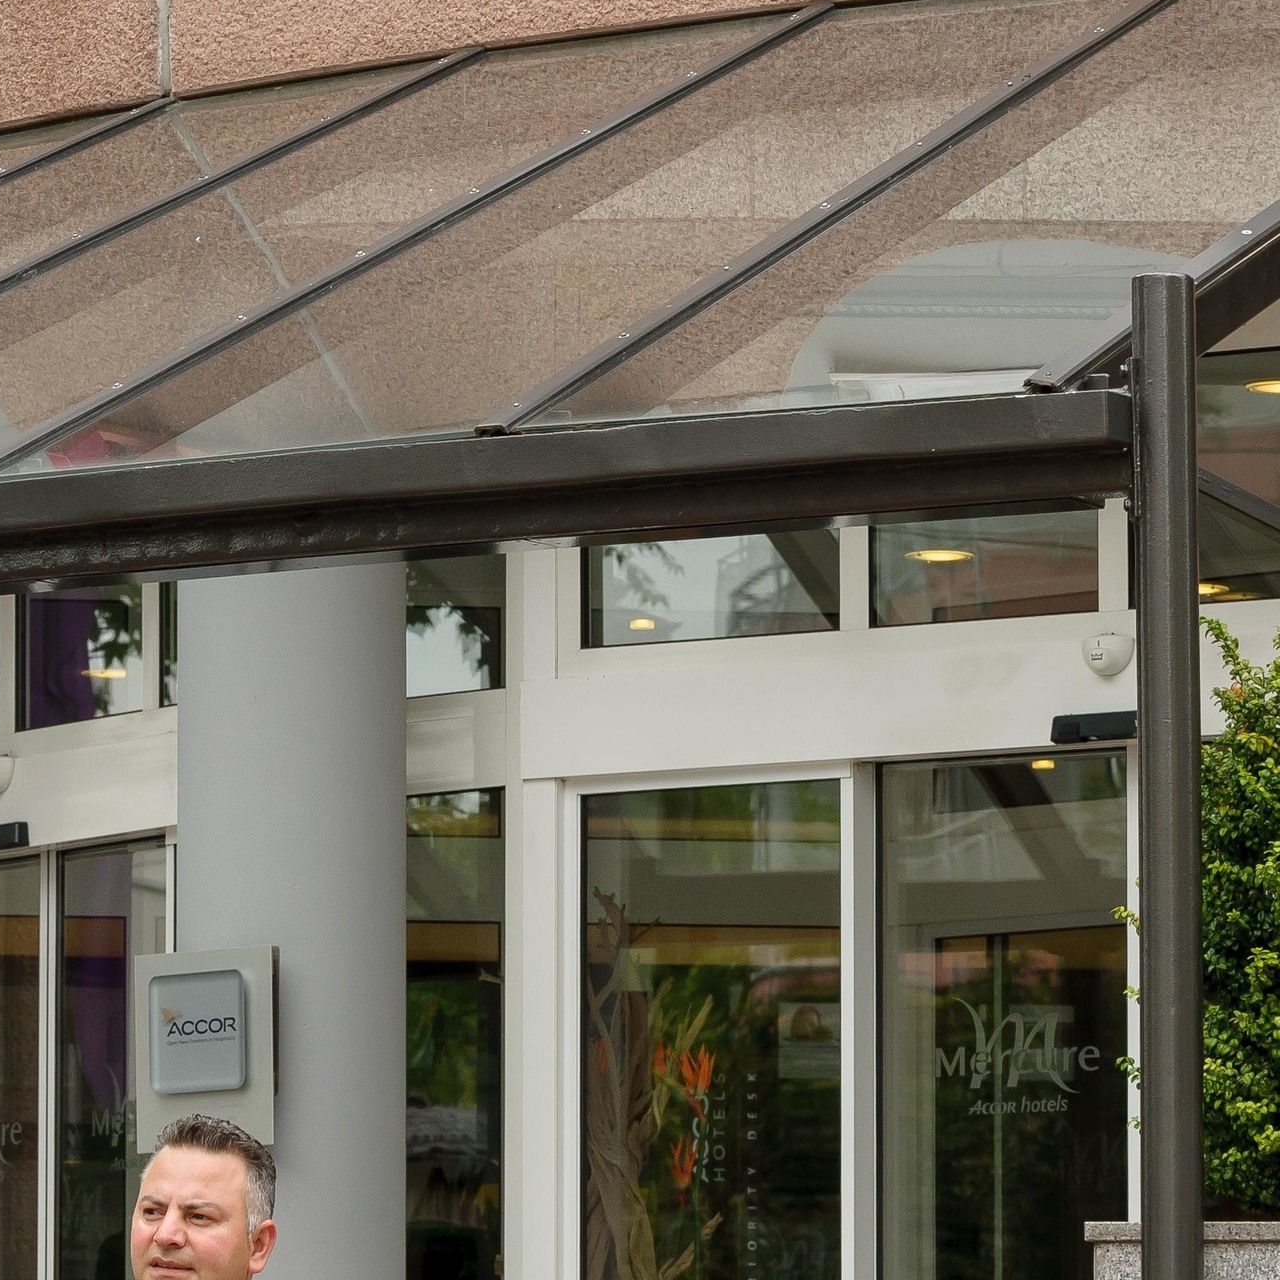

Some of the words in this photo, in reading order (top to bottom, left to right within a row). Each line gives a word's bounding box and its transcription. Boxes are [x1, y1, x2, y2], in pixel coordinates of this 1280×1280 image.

[167, 1016, 237, 1037] ACCOR
[935, 1045, 1101, 1078] Mercure
[746, 1073, 758, 1141] DESK
[1021, 1095, 1068, 1112] hotels
[713, 1072, 726, 1182] HOTELS
